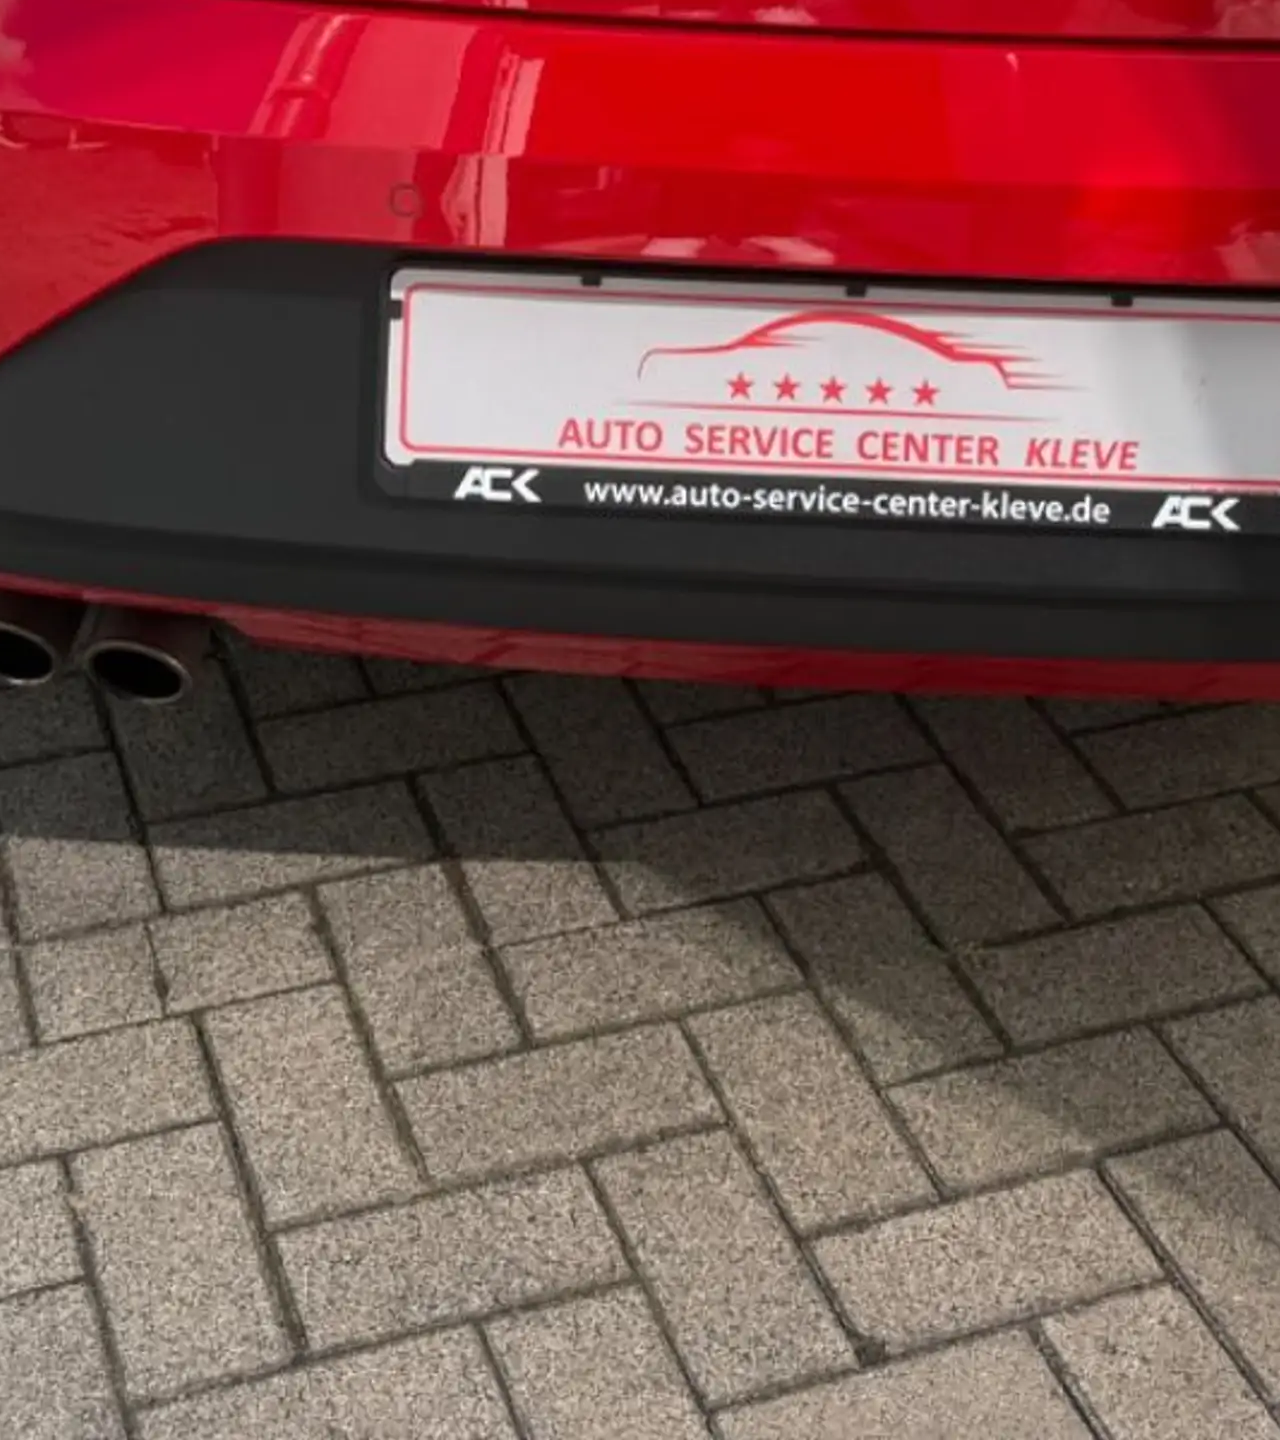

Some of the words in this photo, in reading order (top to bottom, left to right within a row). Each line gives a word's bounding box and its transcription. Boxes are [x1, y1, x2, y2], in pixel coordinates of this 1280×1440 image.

[558, 418, 663, 452] AUTO
[684, 422, 834, 459] SERVICE
[856, 430, 1000, 466] CENTER
[1024, 437, 1140, 471] KLEVE
[453, 465, 542, 503] ACK
[584, 481, 1111, 525] www.auto-service-center-kleve.de
[1151, 495, 1241, 531] ACK
